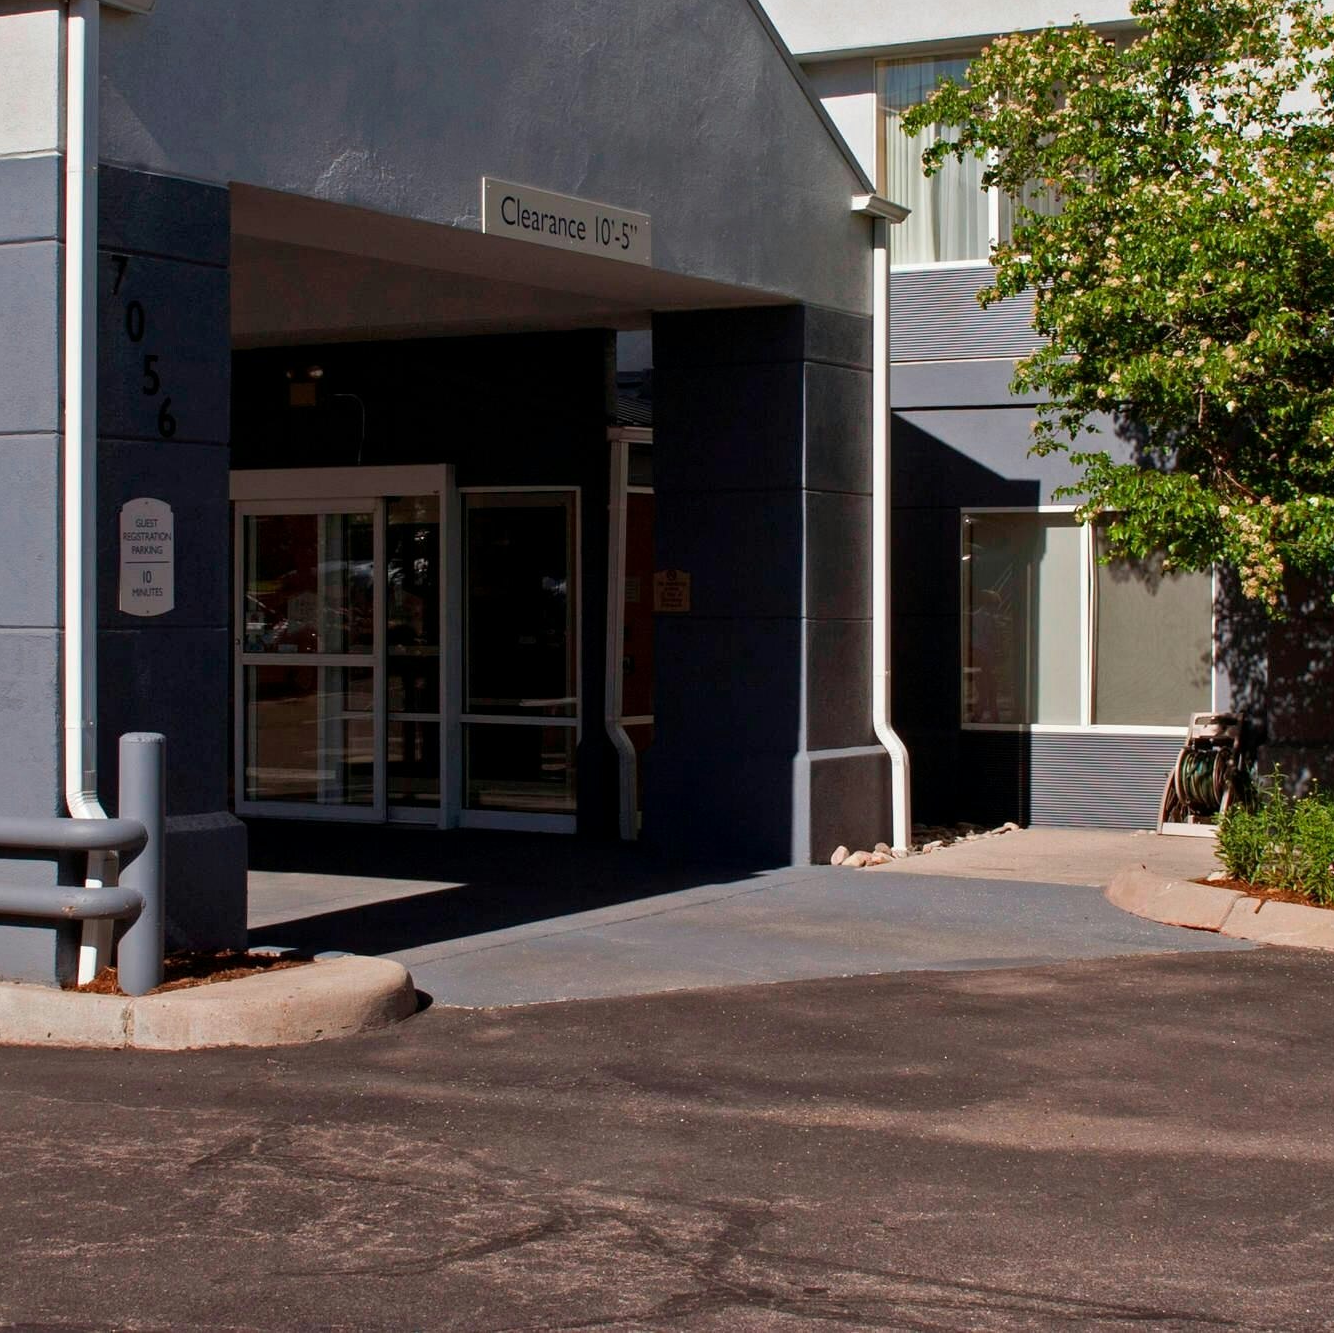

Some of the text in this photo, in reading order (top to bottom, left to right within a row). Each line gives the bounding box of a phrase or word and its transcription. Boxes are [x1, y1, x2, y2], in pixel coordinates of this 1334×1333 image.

[500, 195, 586, 241] Clearance
[135, 518, 158, 528] GUEST
[123, 532, 171, 542] REGISTRATION
[131, 545, 163, 555] PARKING
[142, 570, 152, 584] 10
[132, 587, 163, 597] MINUTES
